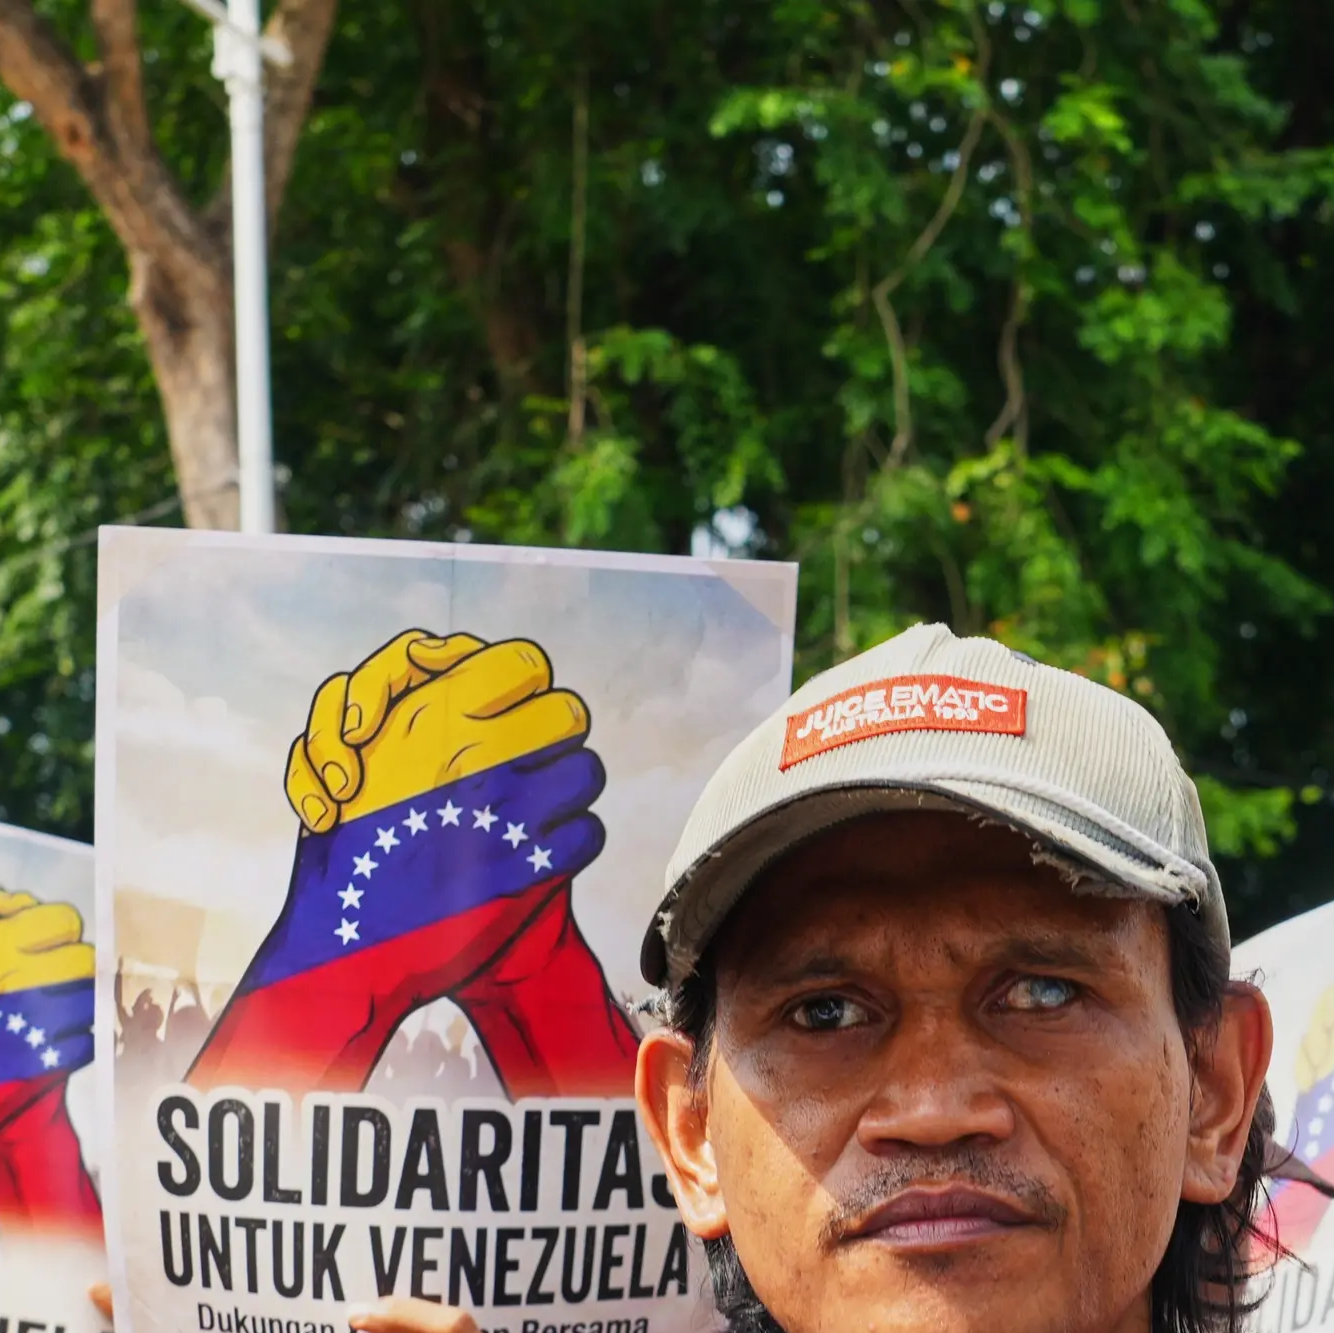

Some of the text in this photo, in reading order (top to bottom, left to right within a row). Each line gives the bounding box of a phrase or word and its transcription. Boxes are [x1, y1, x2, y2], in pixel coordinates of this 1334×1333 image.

[796, 683, 1009, 739] JUICE EMATIC
[820, 704, 925, 741] AUSTRALIA
[156, 1095, 677, 1213] SOLIDARITA
[159, 1209, 689, 1307] UNTUK VENEZUELA
